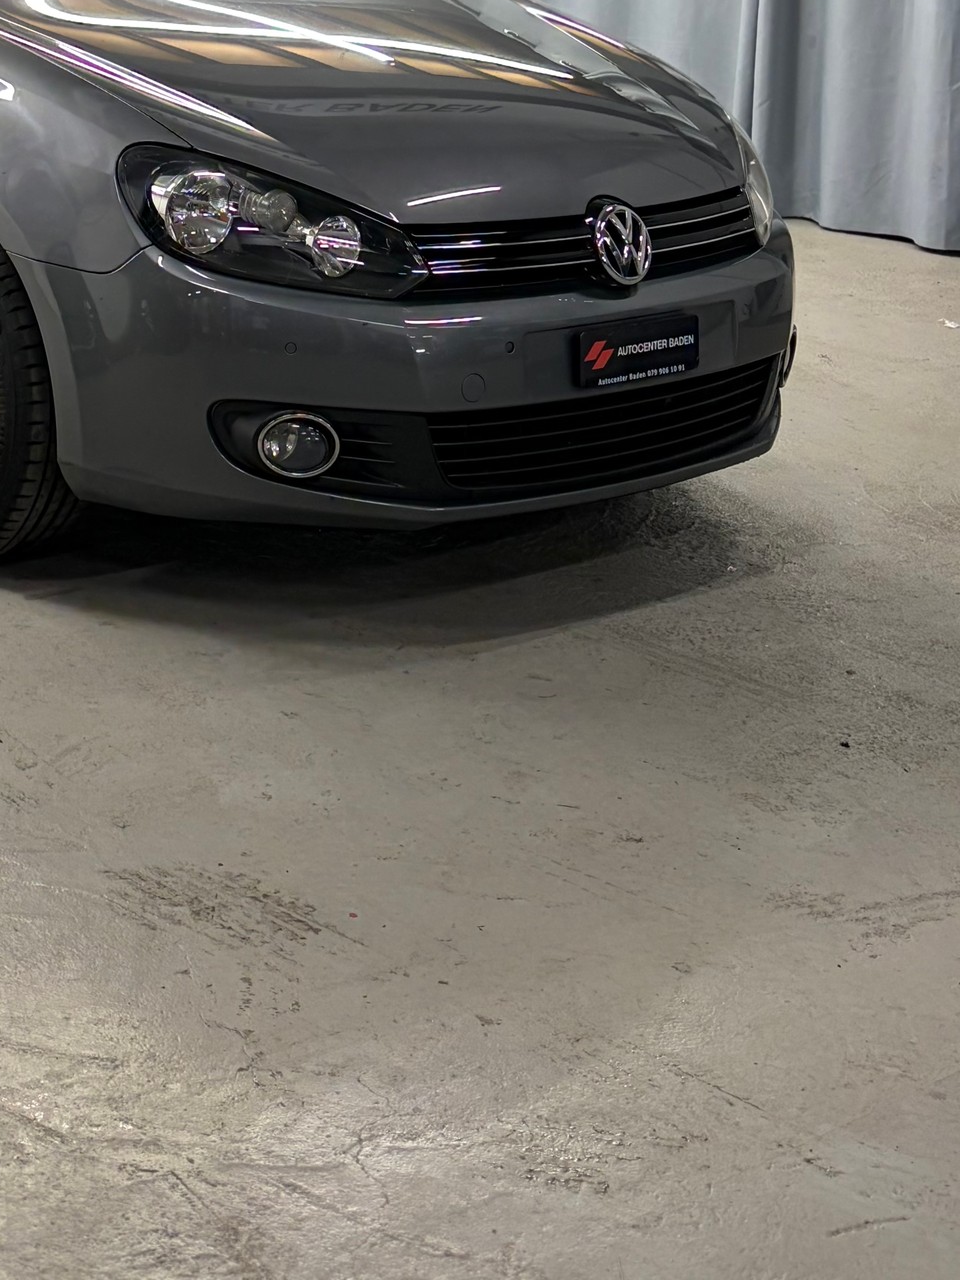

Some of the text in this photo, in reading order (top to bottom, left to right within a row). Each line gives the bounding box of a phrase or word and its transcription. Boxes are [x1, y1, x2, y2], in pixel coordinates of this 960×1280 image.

[617, 334, 694, 357] AUTOCENTER BADEN
[597, 374, 629, 386] Autocenter
[629, 371, 647, 381] Baden
[647, 368, 658, 378] 079
[670, 365, 678, 373] 10
